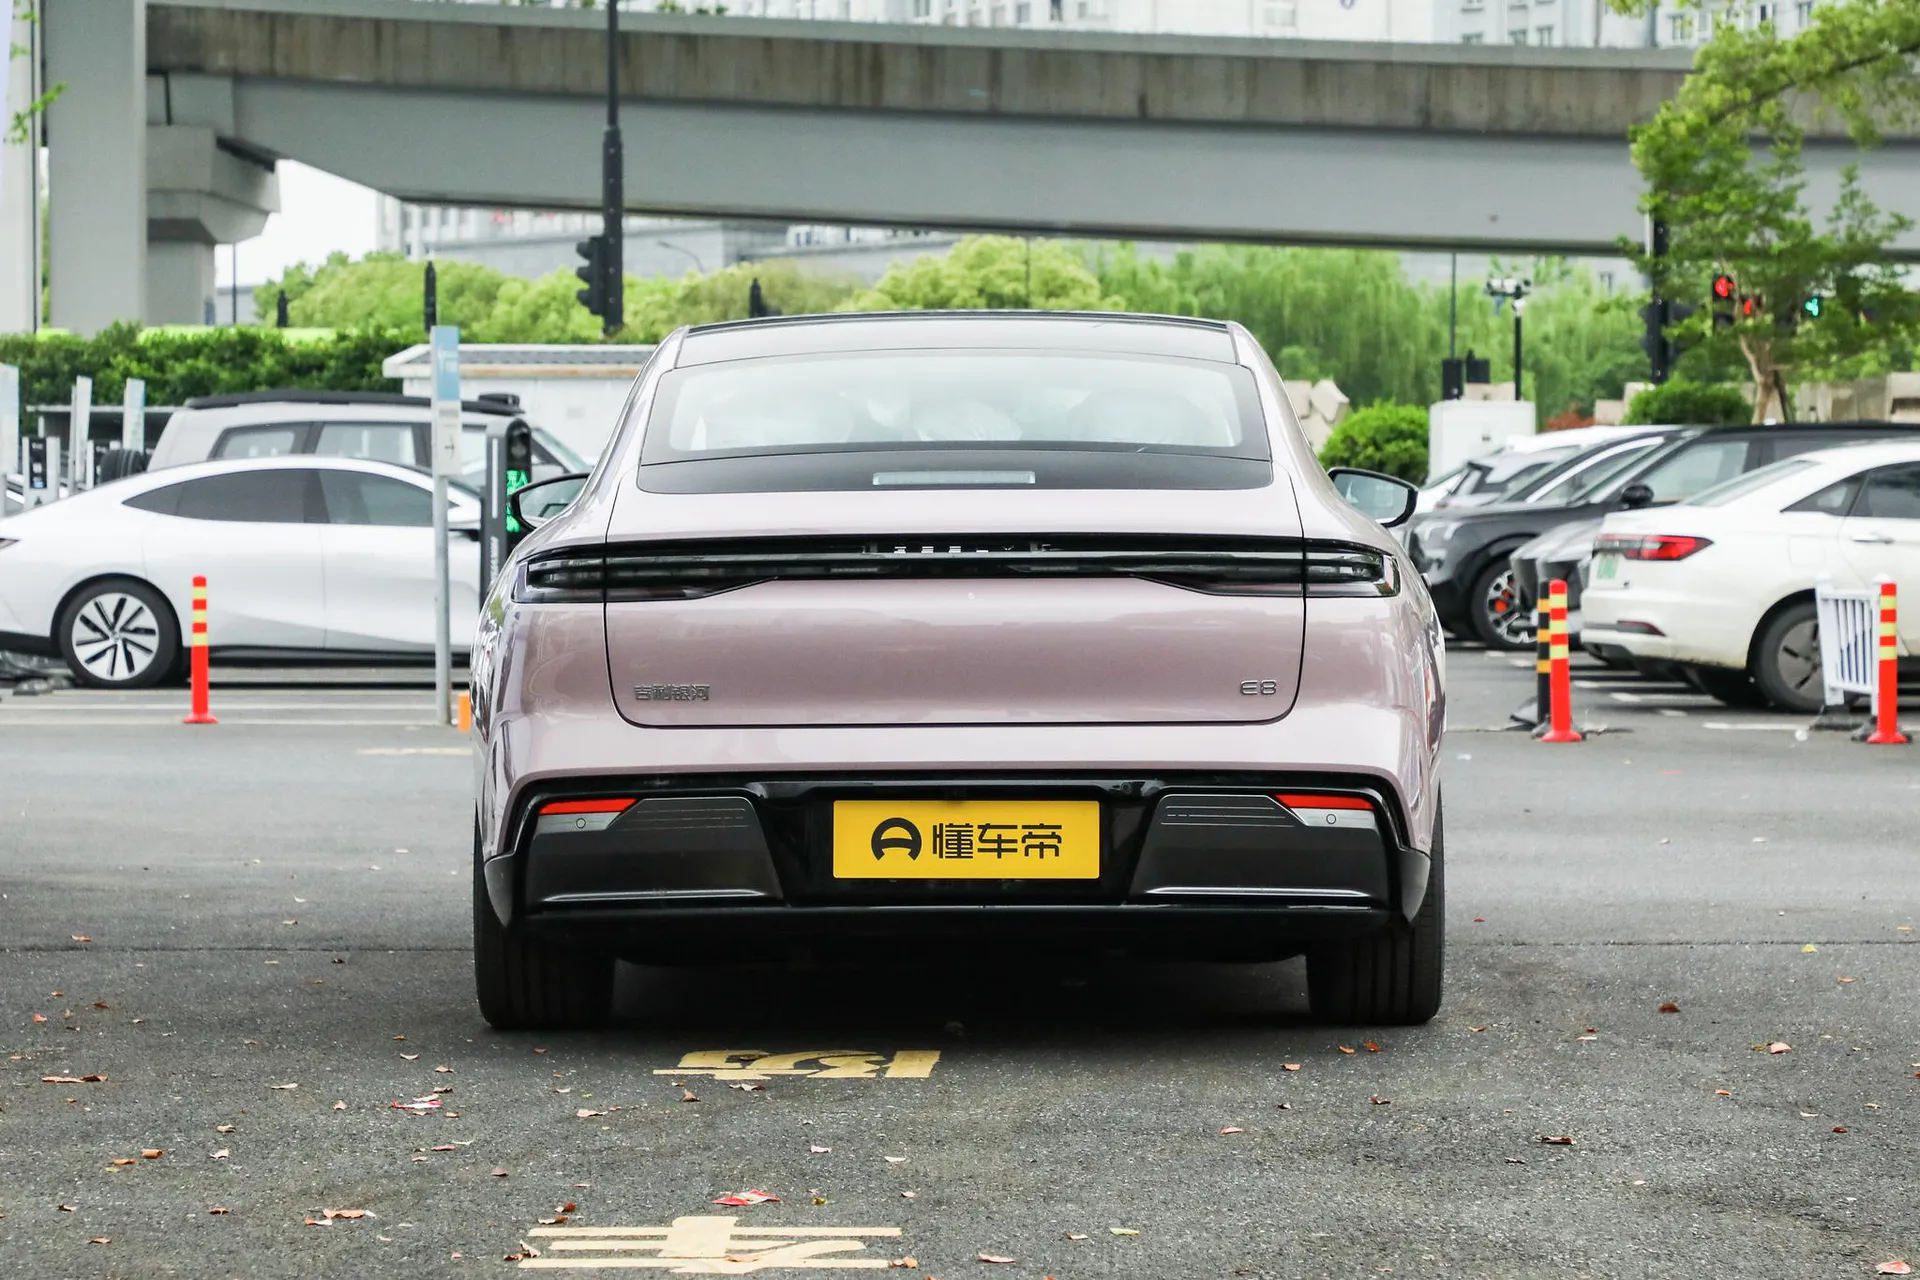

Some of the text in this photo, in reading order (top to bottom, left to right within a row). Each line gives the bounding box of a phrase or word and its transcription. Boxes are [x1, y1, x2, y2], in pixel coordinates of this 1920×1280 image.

[635, 683, 710, 702] 吉利银河
[1240, 679, 1277, 696] E8
[932, 823, 1062, 859] 懂车帝
